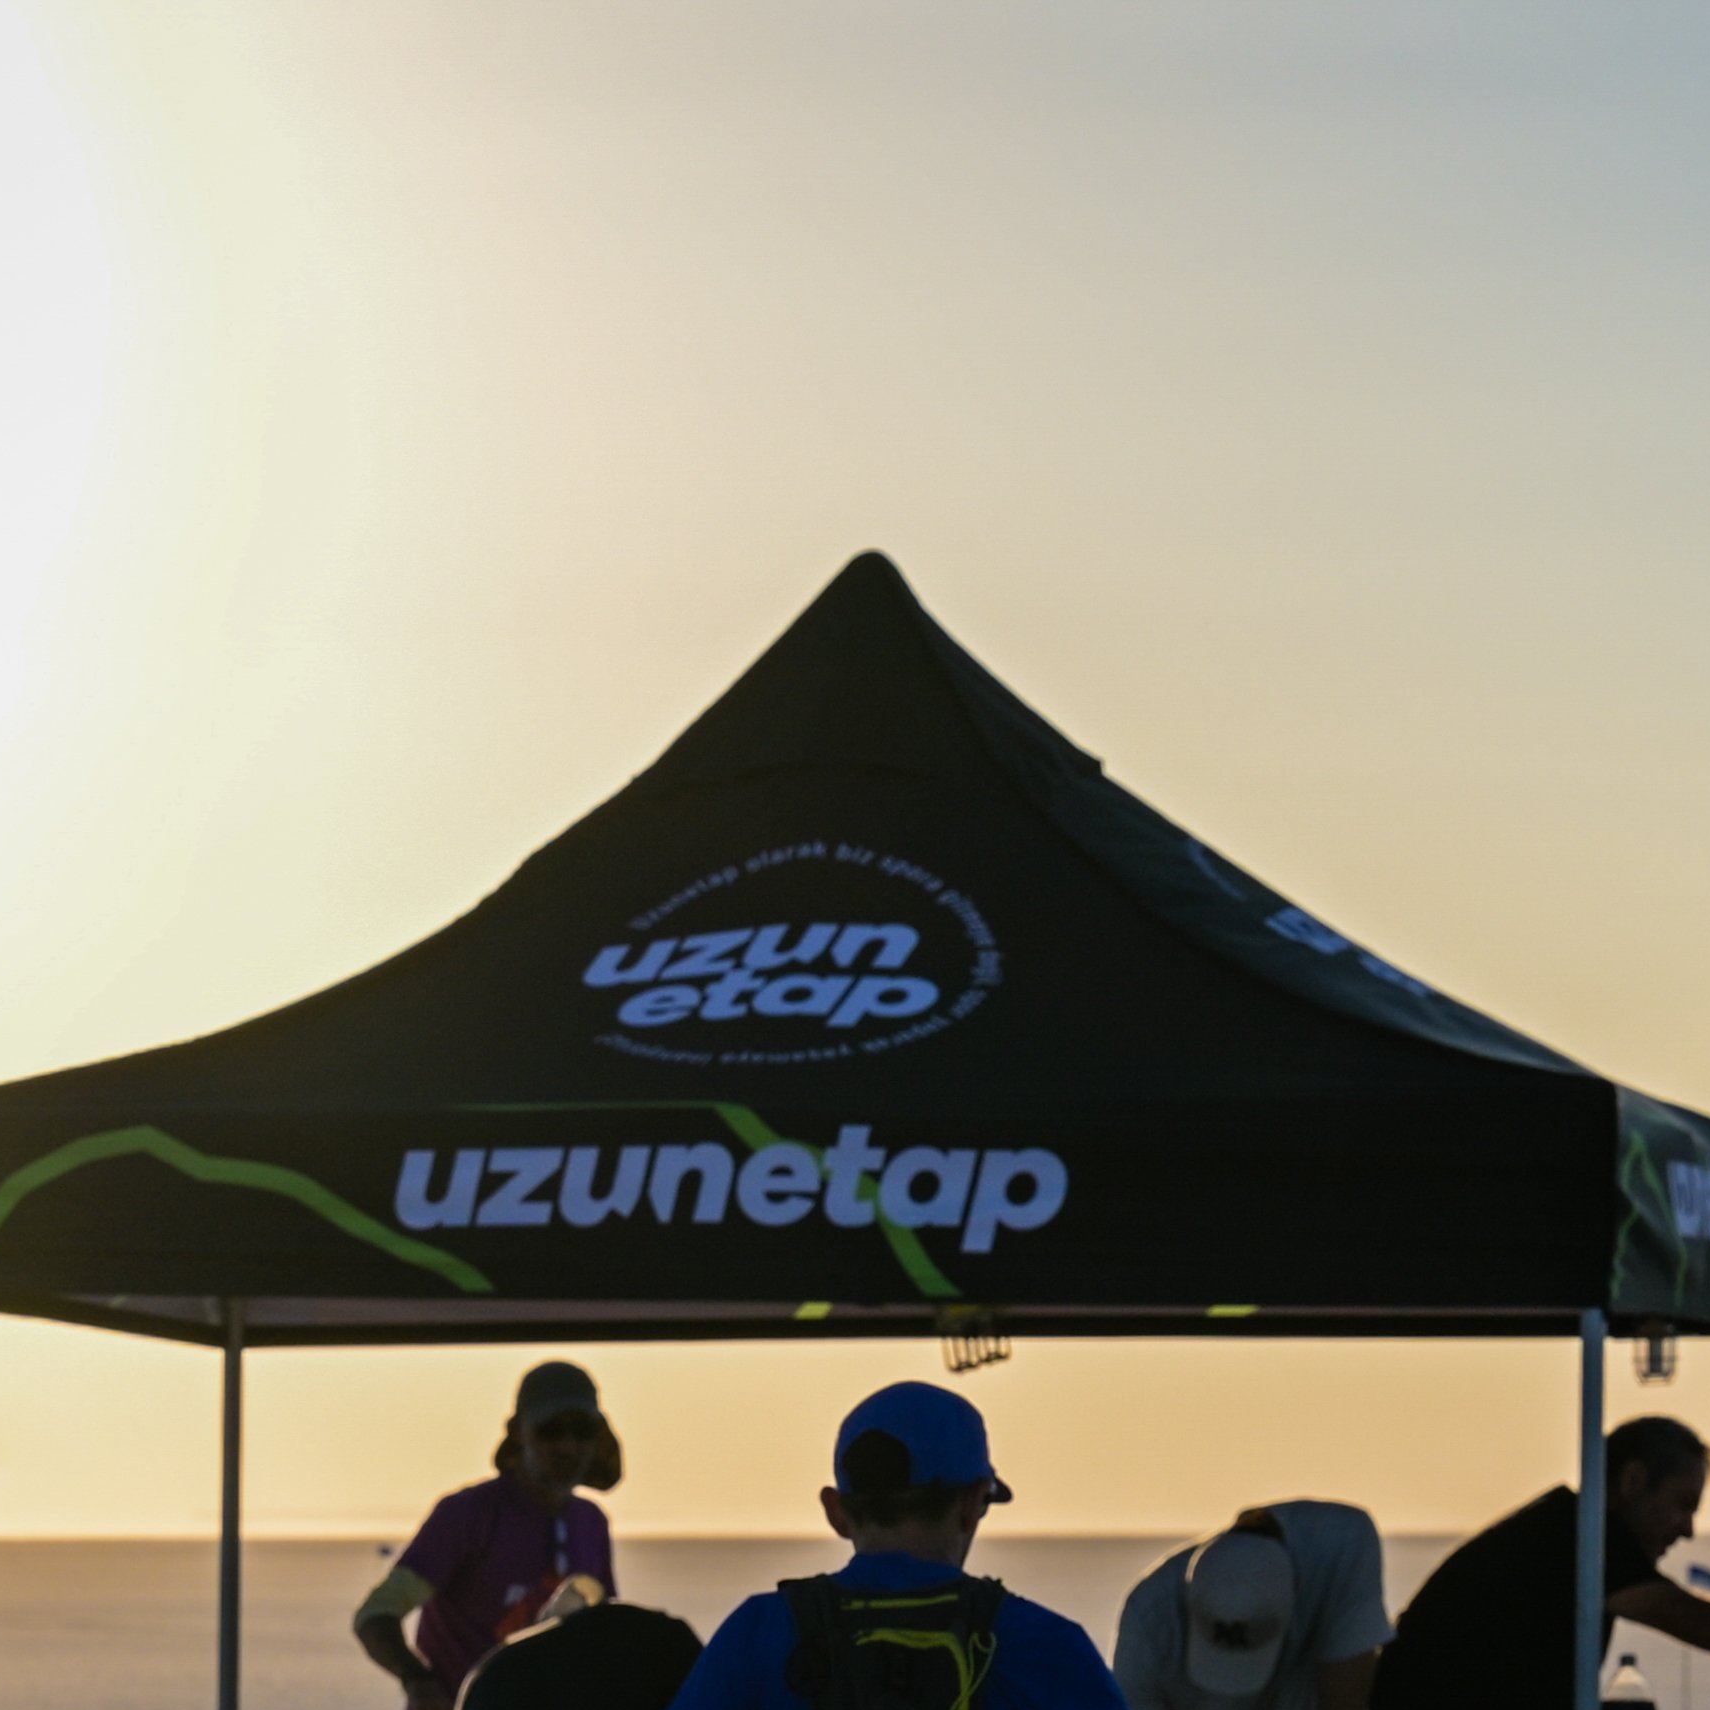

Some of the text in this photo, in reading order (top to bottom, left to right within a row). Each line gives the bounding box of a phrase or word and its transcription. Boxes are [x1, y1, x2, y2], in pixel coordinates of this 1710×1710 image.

[582, 922, 920, 988] uzun
[616, 969, 940, 1028] etap
[394, 1124, 1068, 1253] uzunetap
